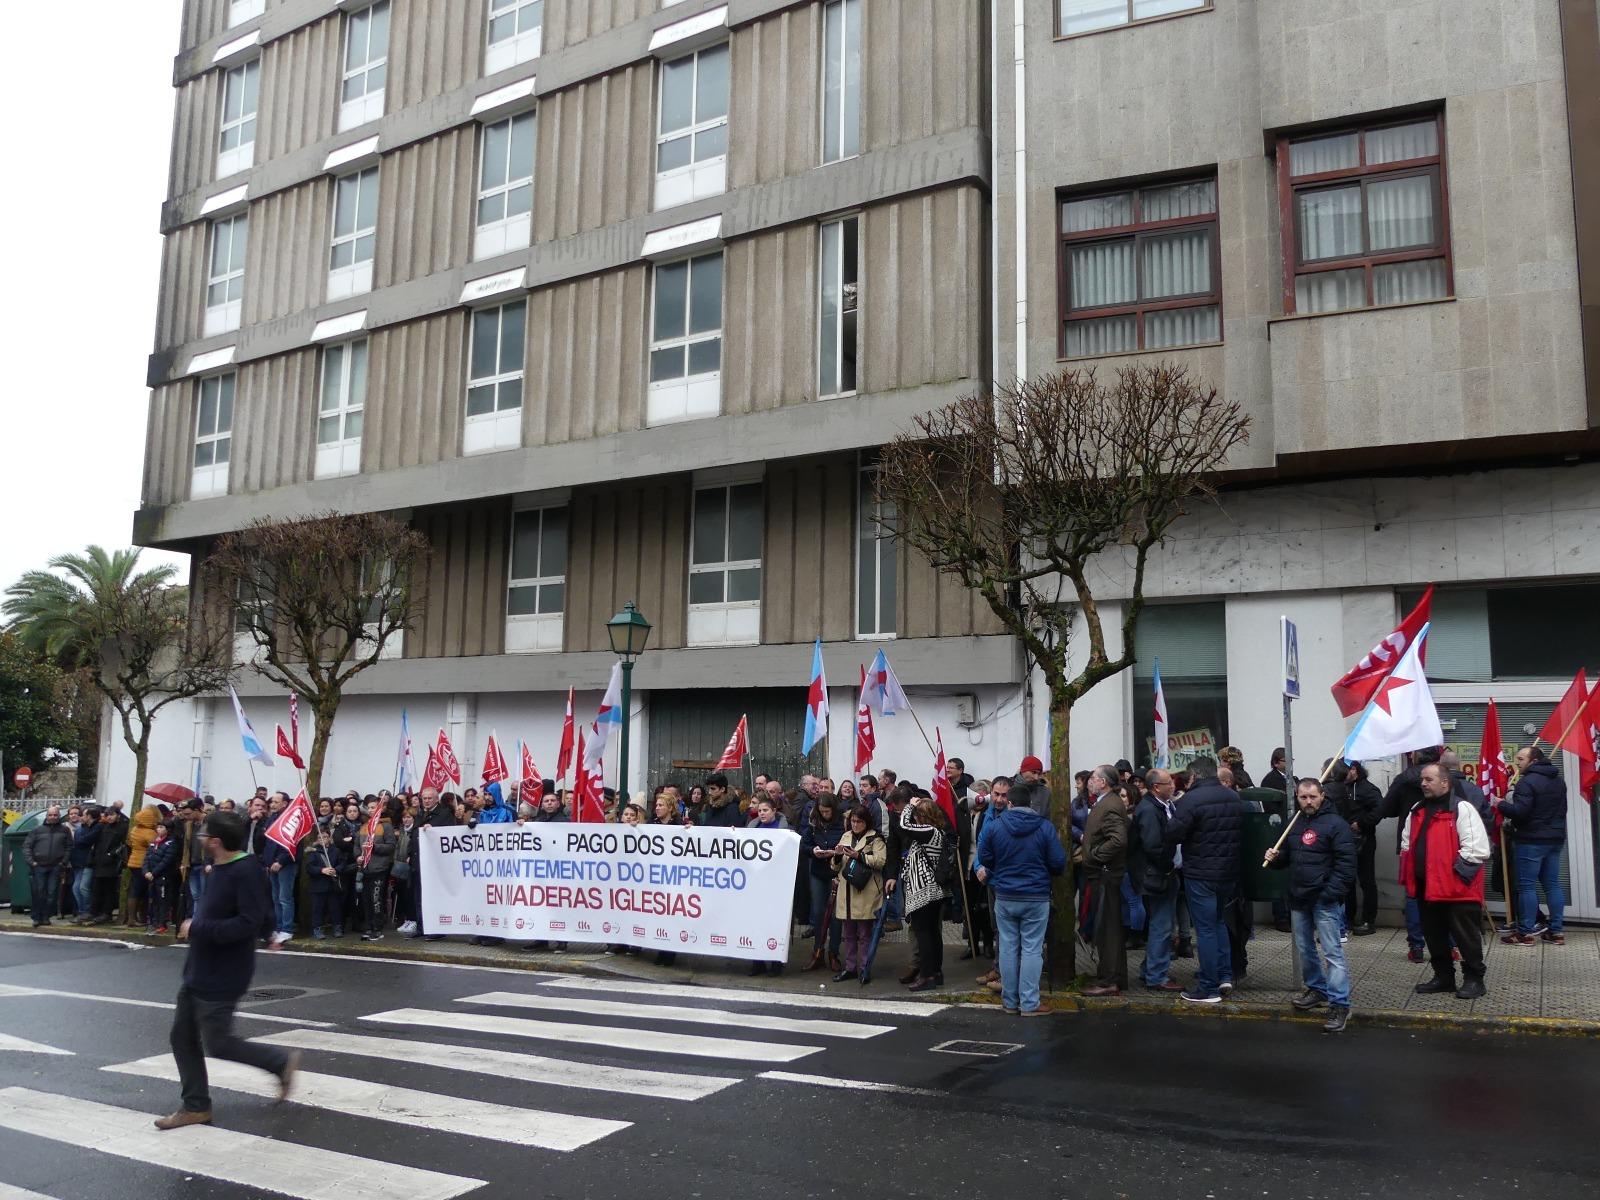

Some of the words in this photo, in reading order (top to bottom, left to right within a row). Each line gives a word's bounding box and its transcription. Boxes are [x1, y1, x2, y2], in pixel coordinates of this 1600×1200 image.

[440, 833, 485, 854] BASTA
[488, 832, 503, 851] DE
[506, 832, 542, 851] EREs
[567, 833, 618, 854] PAGO
[623, 834, 665, 856] DOS
[670, 835, 773, 862] SALARIOS
[461, 858, 494, 878] POLO
[496, 858, 612, 882] MANTEMENTO
[617, 861, 645, 883] DO
[649, 863, 747, 891] EMPREGO
[486, 884, 503, 905] EN
[506, 884, 604, 910] MADERAS
[609, 887, 702, 919] IGLESIAS
